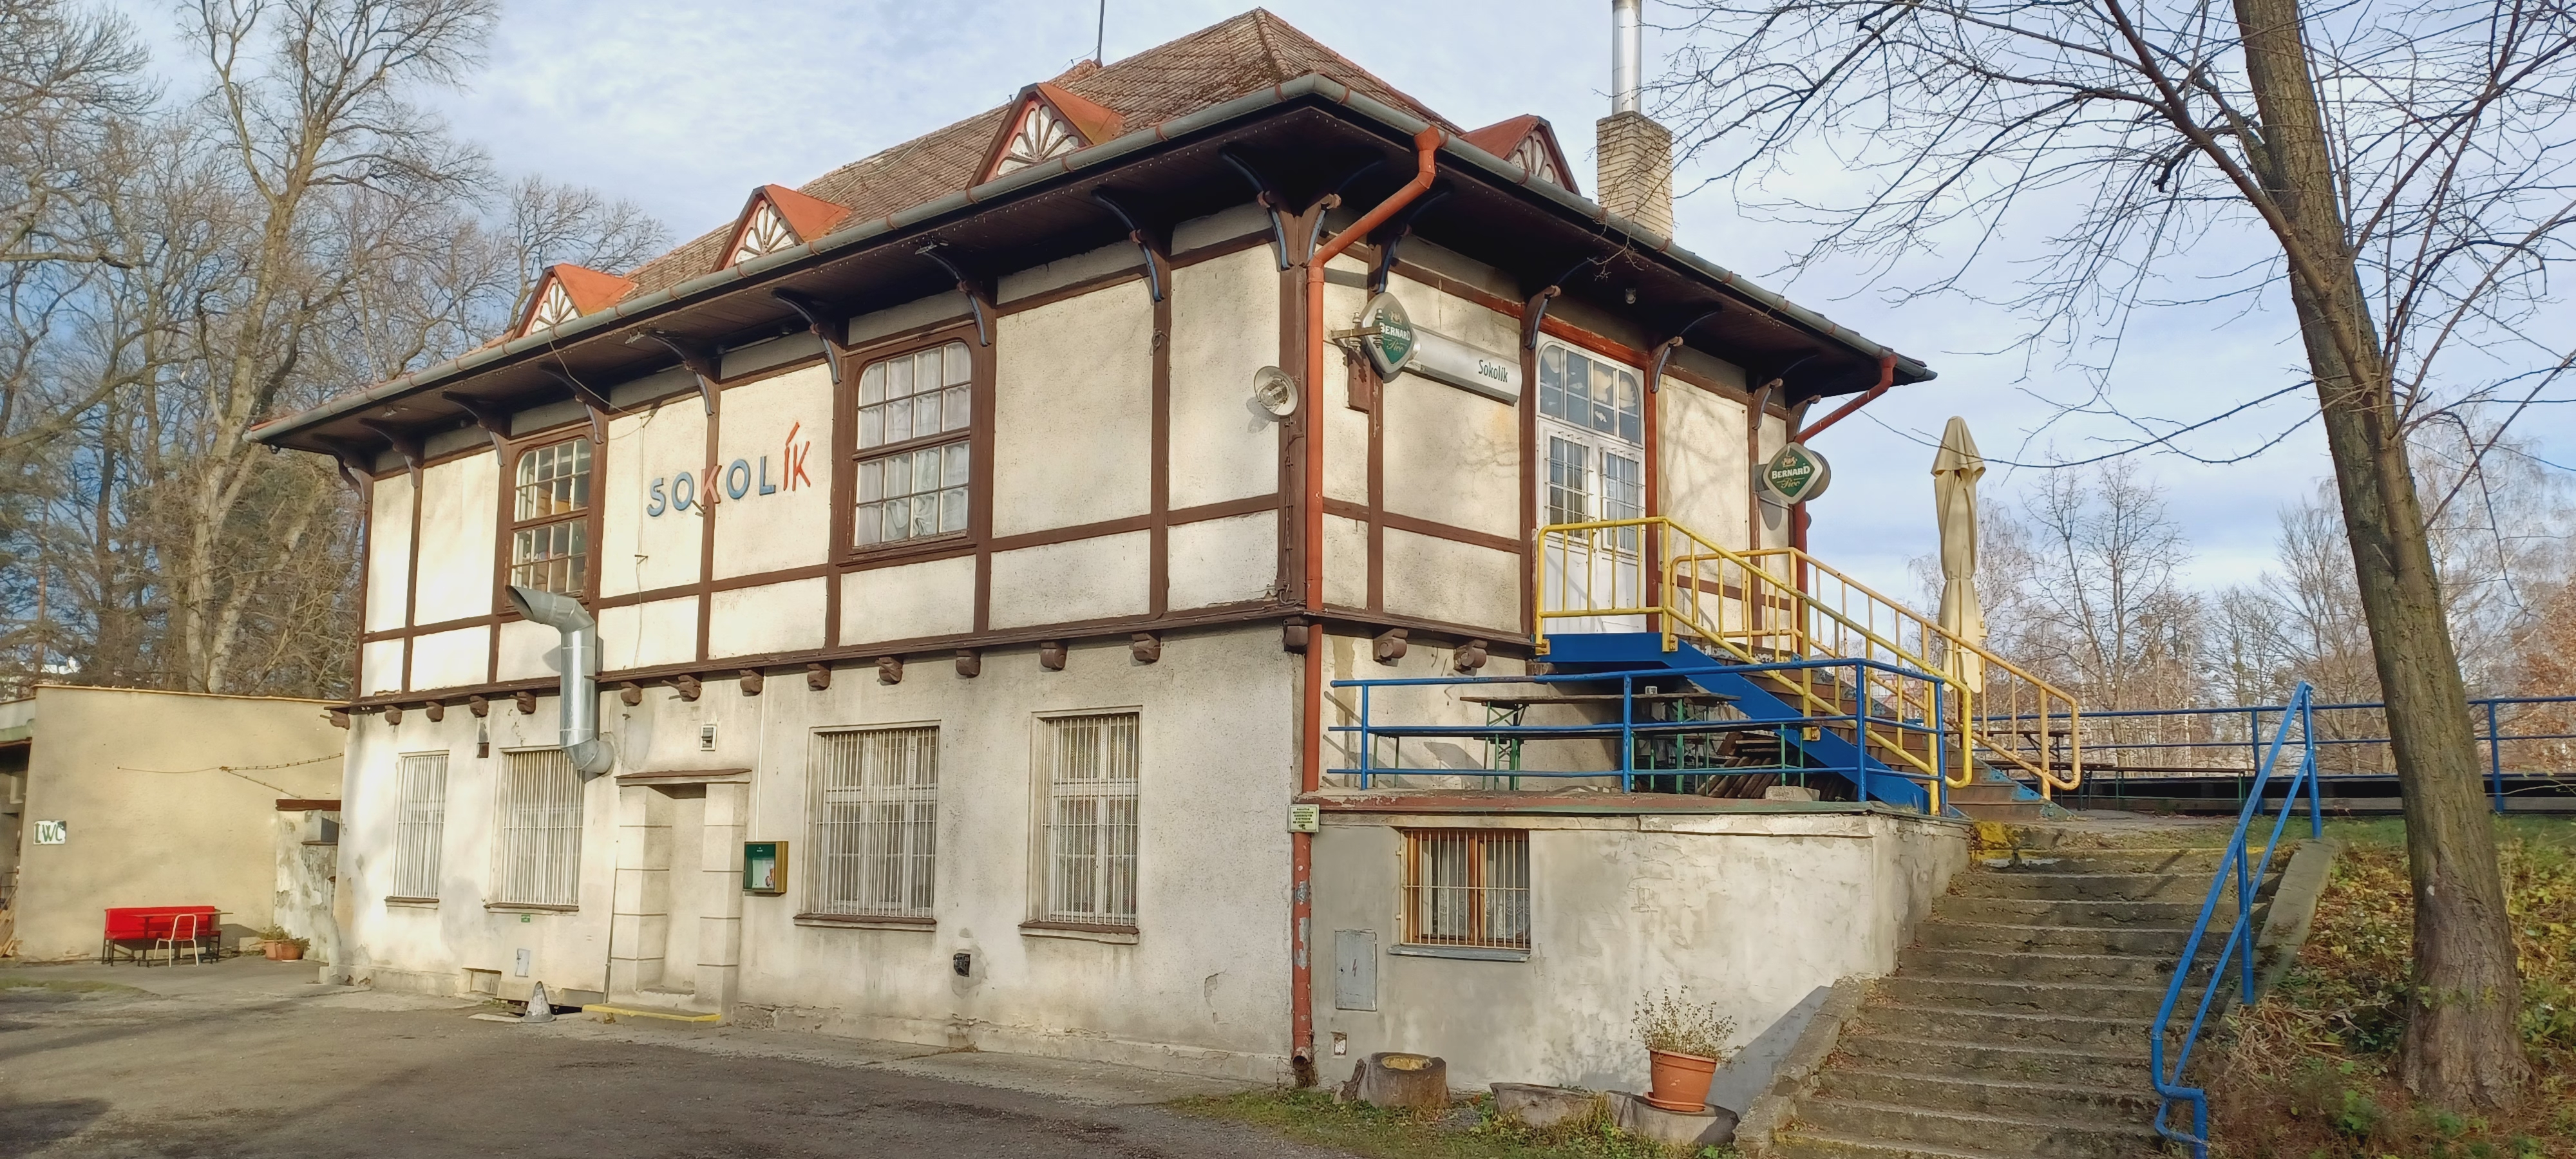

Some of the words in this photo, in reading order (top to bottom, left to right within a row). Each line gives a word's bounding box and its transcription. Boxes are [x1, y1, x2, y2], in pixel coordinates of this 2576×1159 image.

[1478, 359, 1508, 383] Sokolík
[646, 421, 811, 517] SOKOLÍK
[1772, 465, 1811, 480] BERNARD
